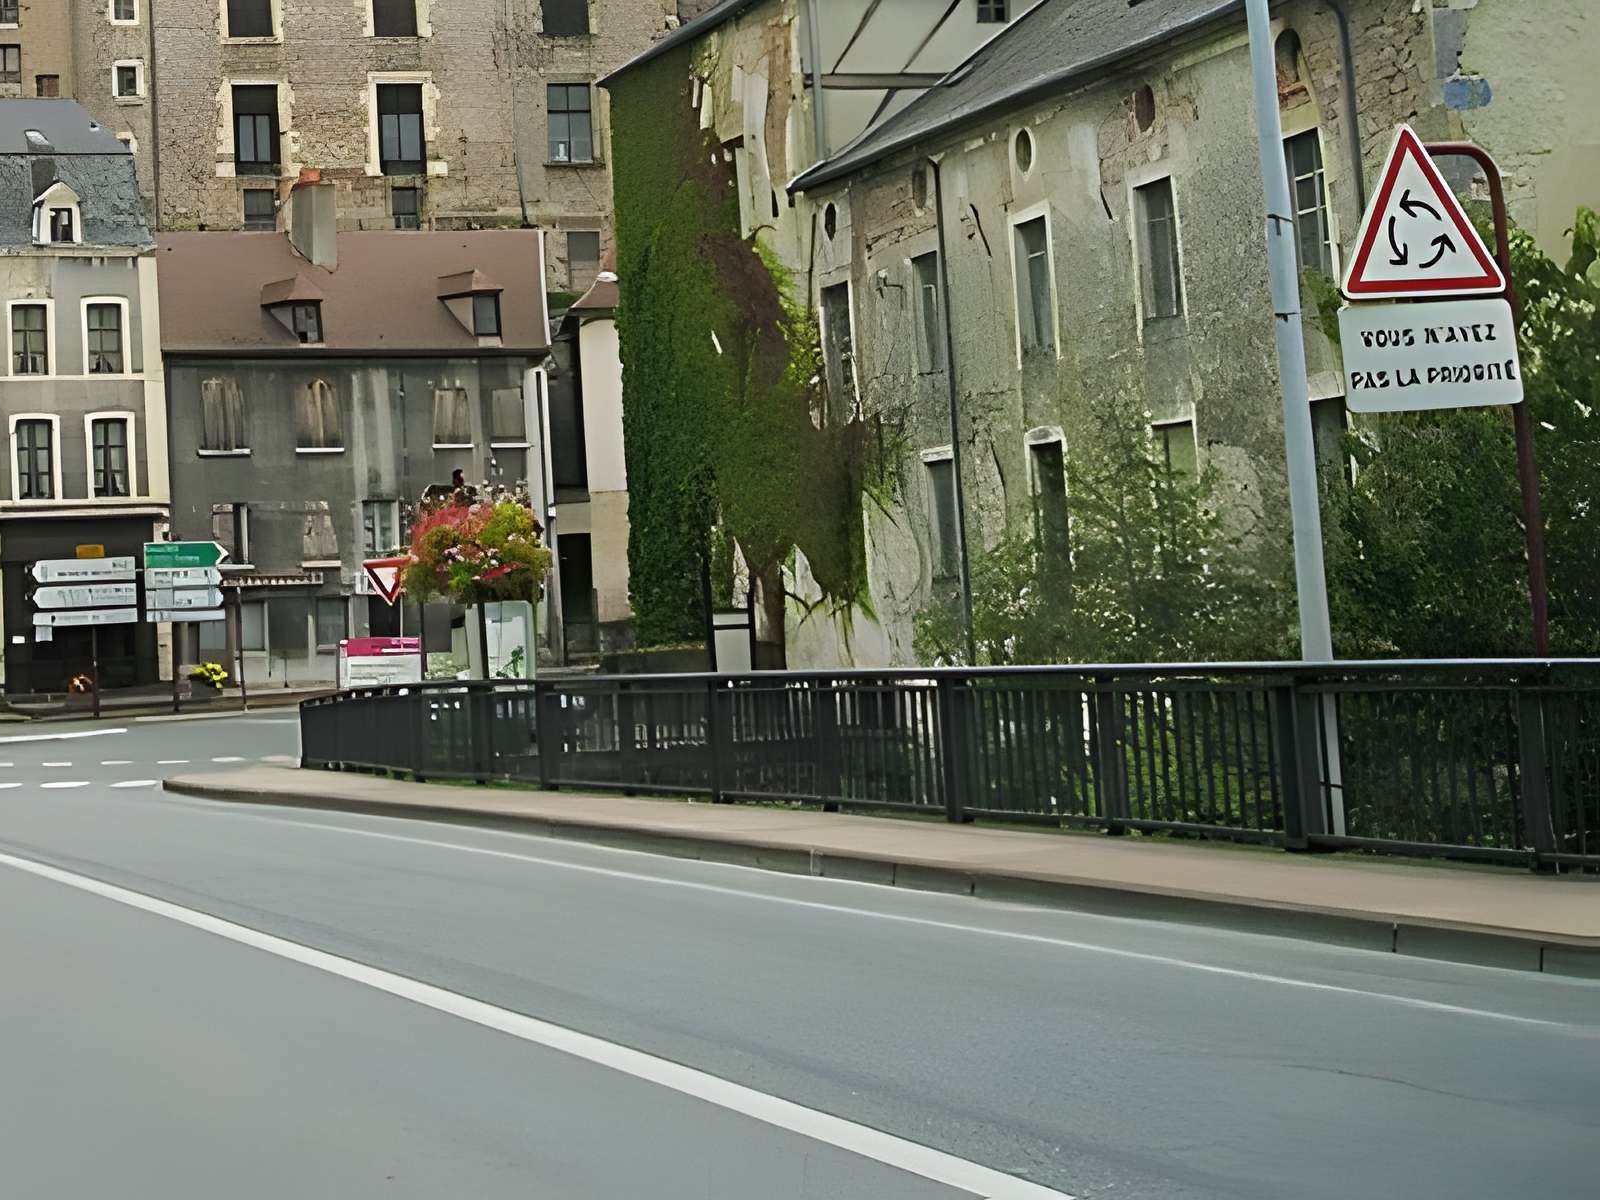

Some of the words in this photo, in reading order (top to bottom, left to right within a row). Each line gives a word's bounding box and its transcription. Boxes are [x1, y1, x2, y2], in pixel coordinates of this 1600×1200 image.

[1360, 328, 1415, 347] VOUS
[1351, 371, 1390, 389] PAS
[1396, 368, 1421, 387] LA
